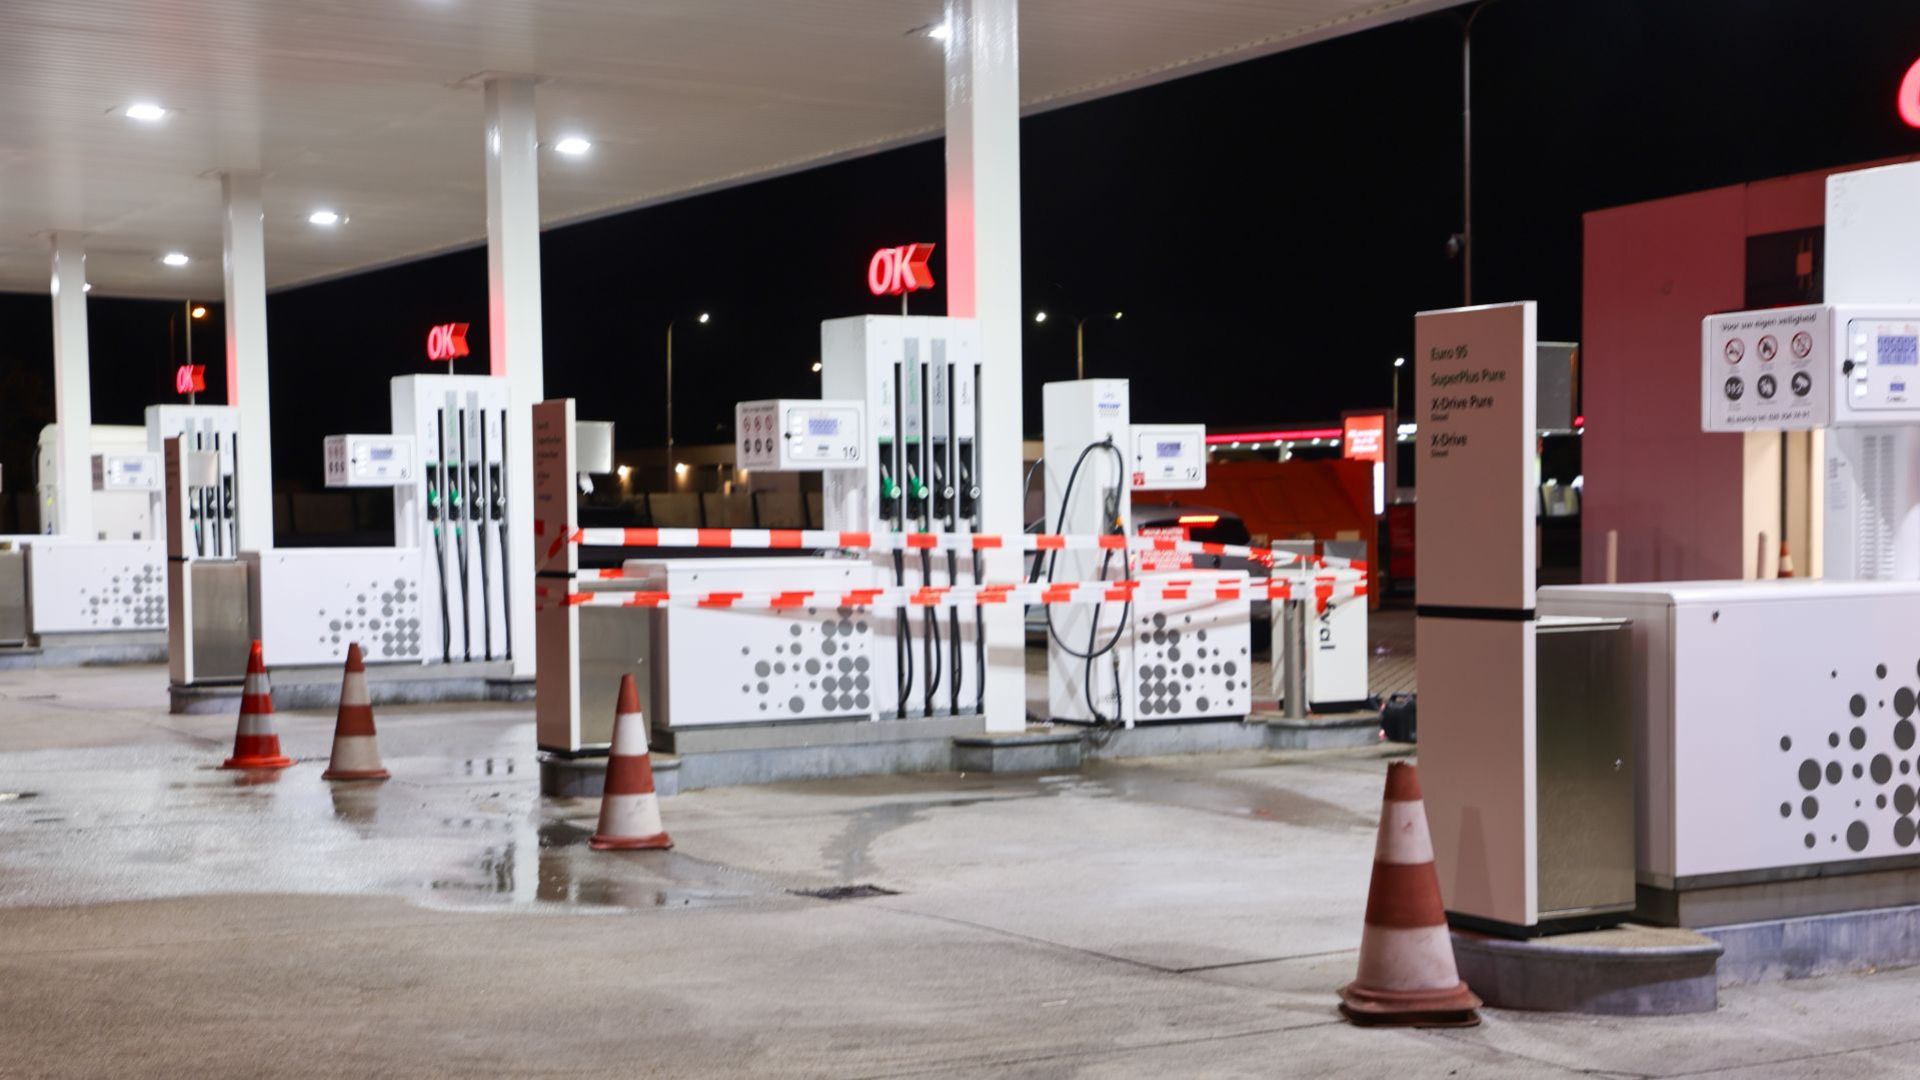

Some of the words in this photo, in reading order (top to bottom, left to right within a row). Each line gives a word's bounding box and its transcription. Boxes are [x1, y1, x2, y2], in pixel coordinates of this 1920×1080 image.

[868, 243, 919, 296] OK
[427, 322, 455, 361] OK
[1430, 346, 1454, 360] Euro
[1456, 344, 1468, 359] 95
[176, 365, 194, 394] OK
[1430, 371, 1479, 387] SuperPlus
[1481, 368, 1506, 381] Pure
[1430, 397, 1468, 411] X-Drive
[1469, 395, 1494, 408] Pure
[1430, 432, 1467, 447] X-Drive
[843, 446, 857, 459] 10
